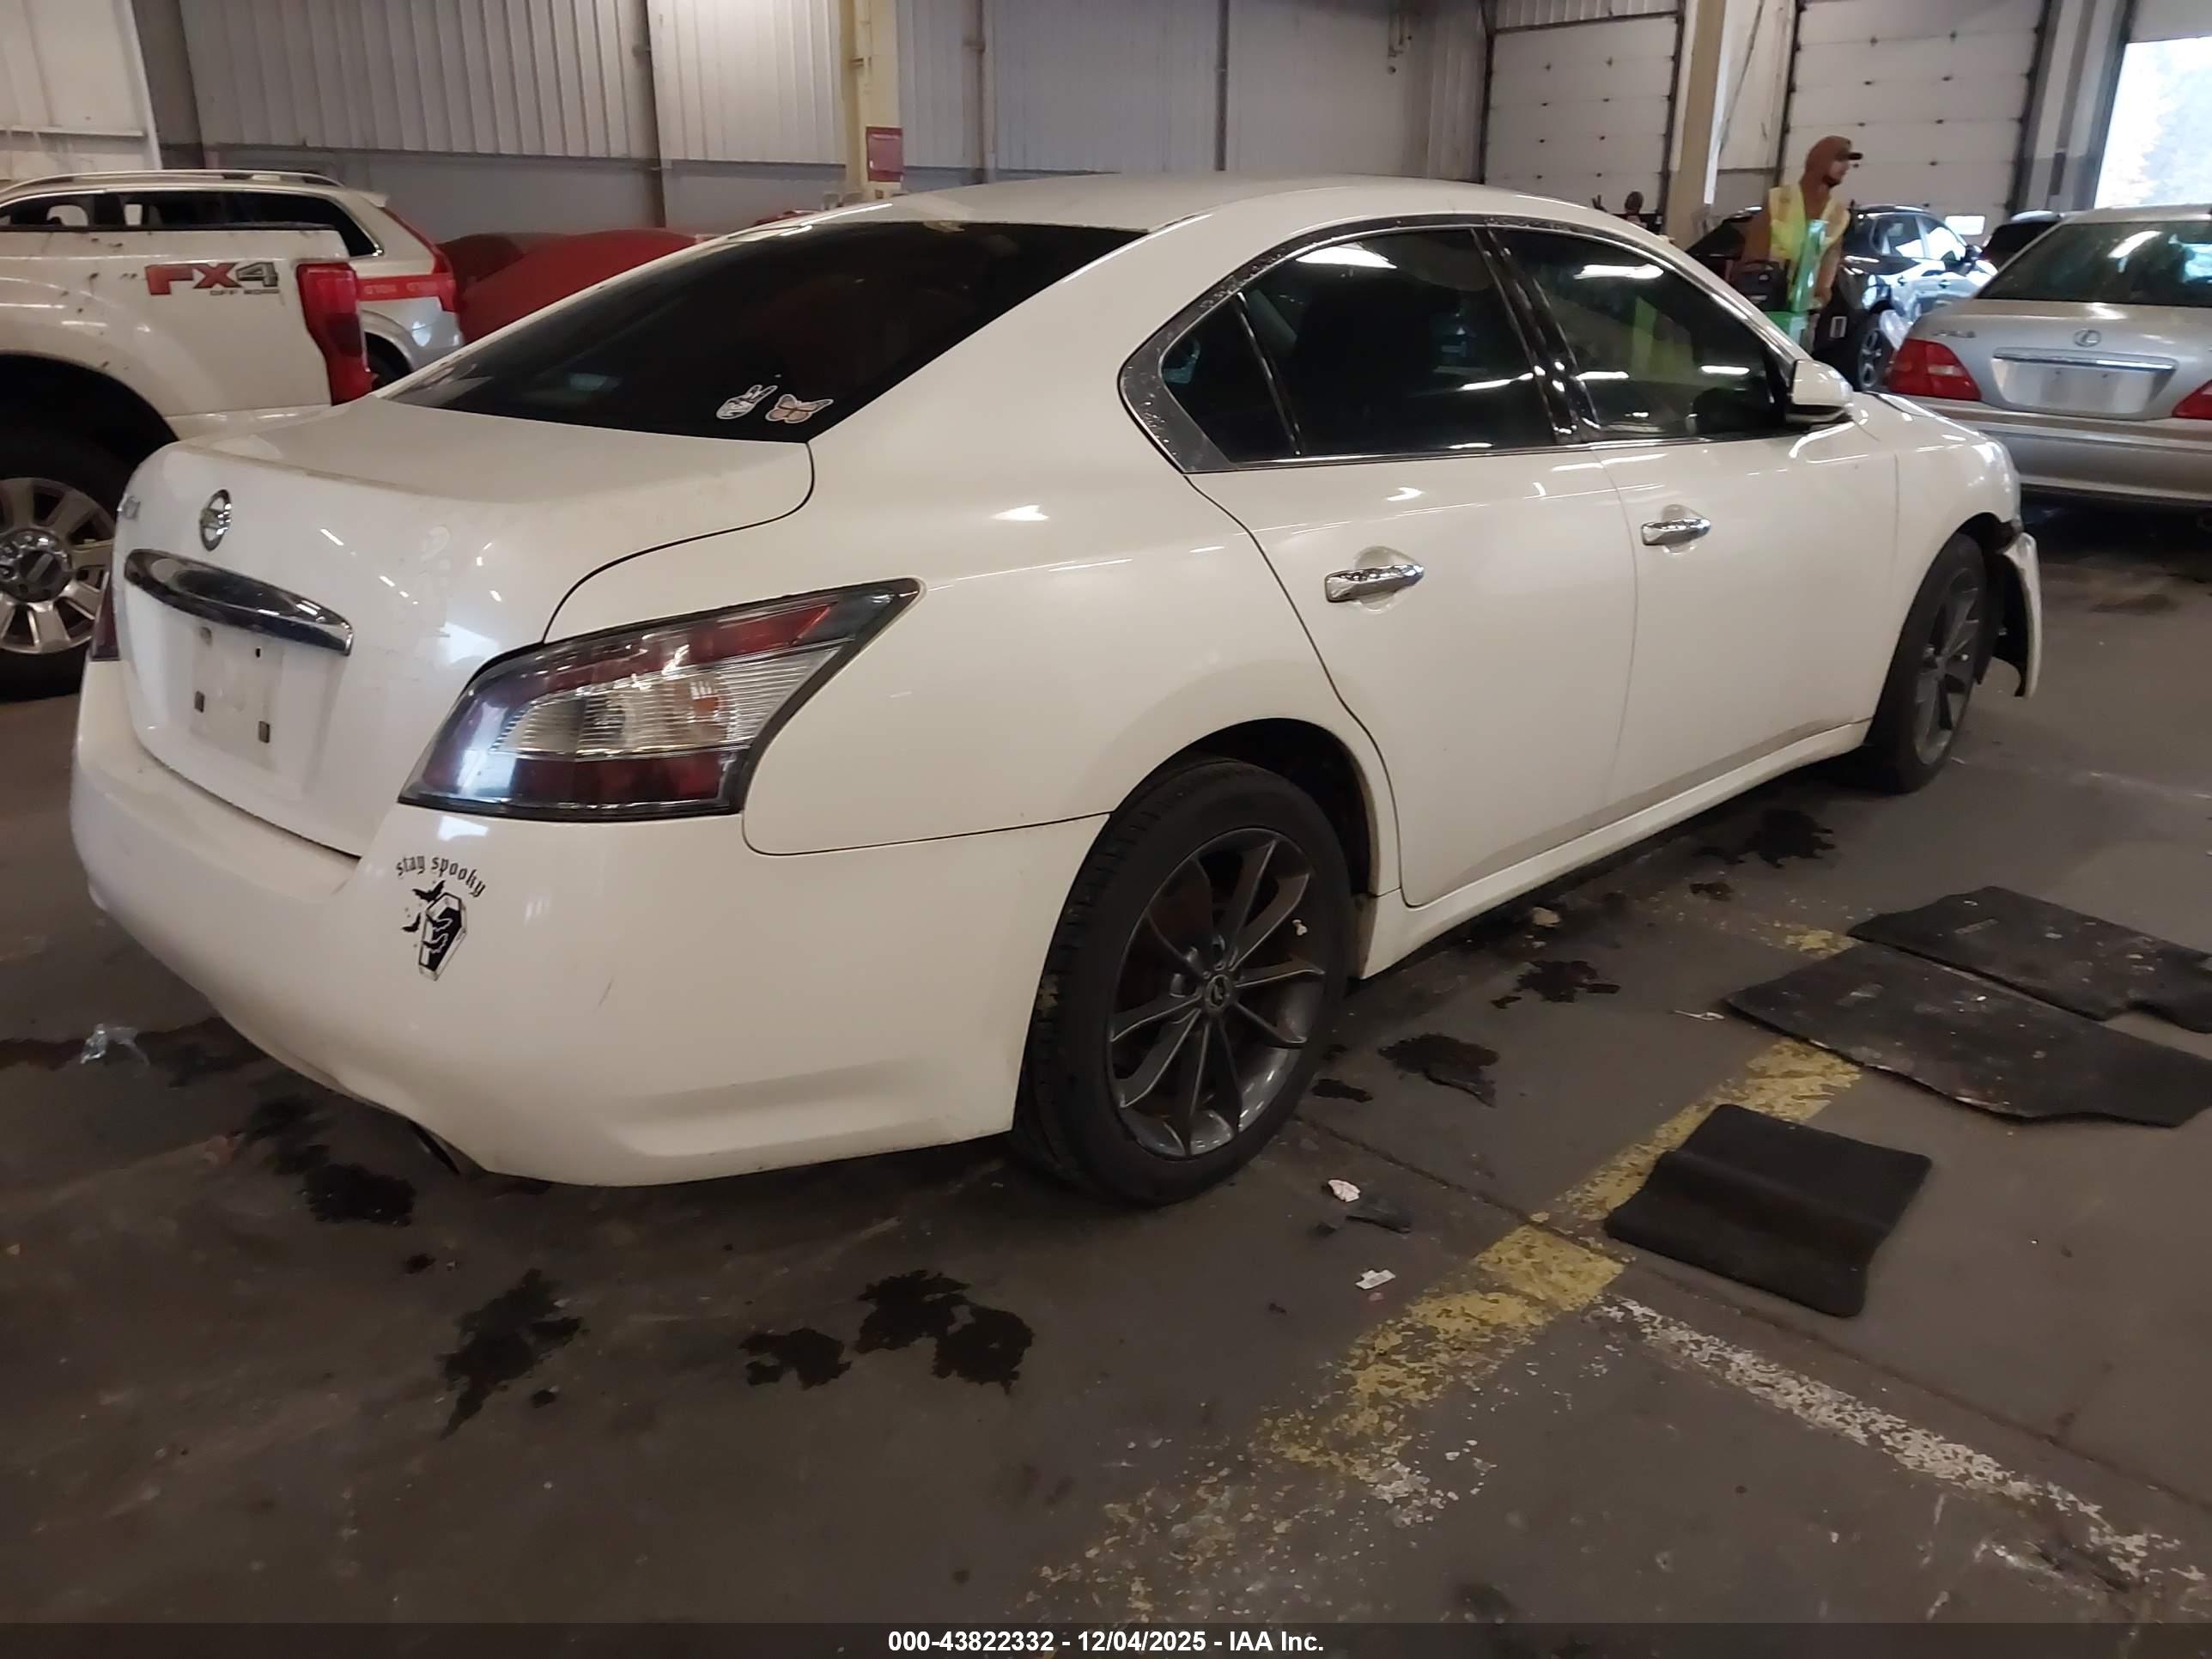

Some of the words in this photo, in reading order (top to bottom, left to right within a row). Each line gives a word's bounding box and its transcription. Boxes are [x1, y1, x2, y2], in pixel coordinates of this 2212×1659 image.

[145, 261, 278, 295] FX4
[396, 855, 426, 877] stay
[430, 856, 486, 898] spooky
